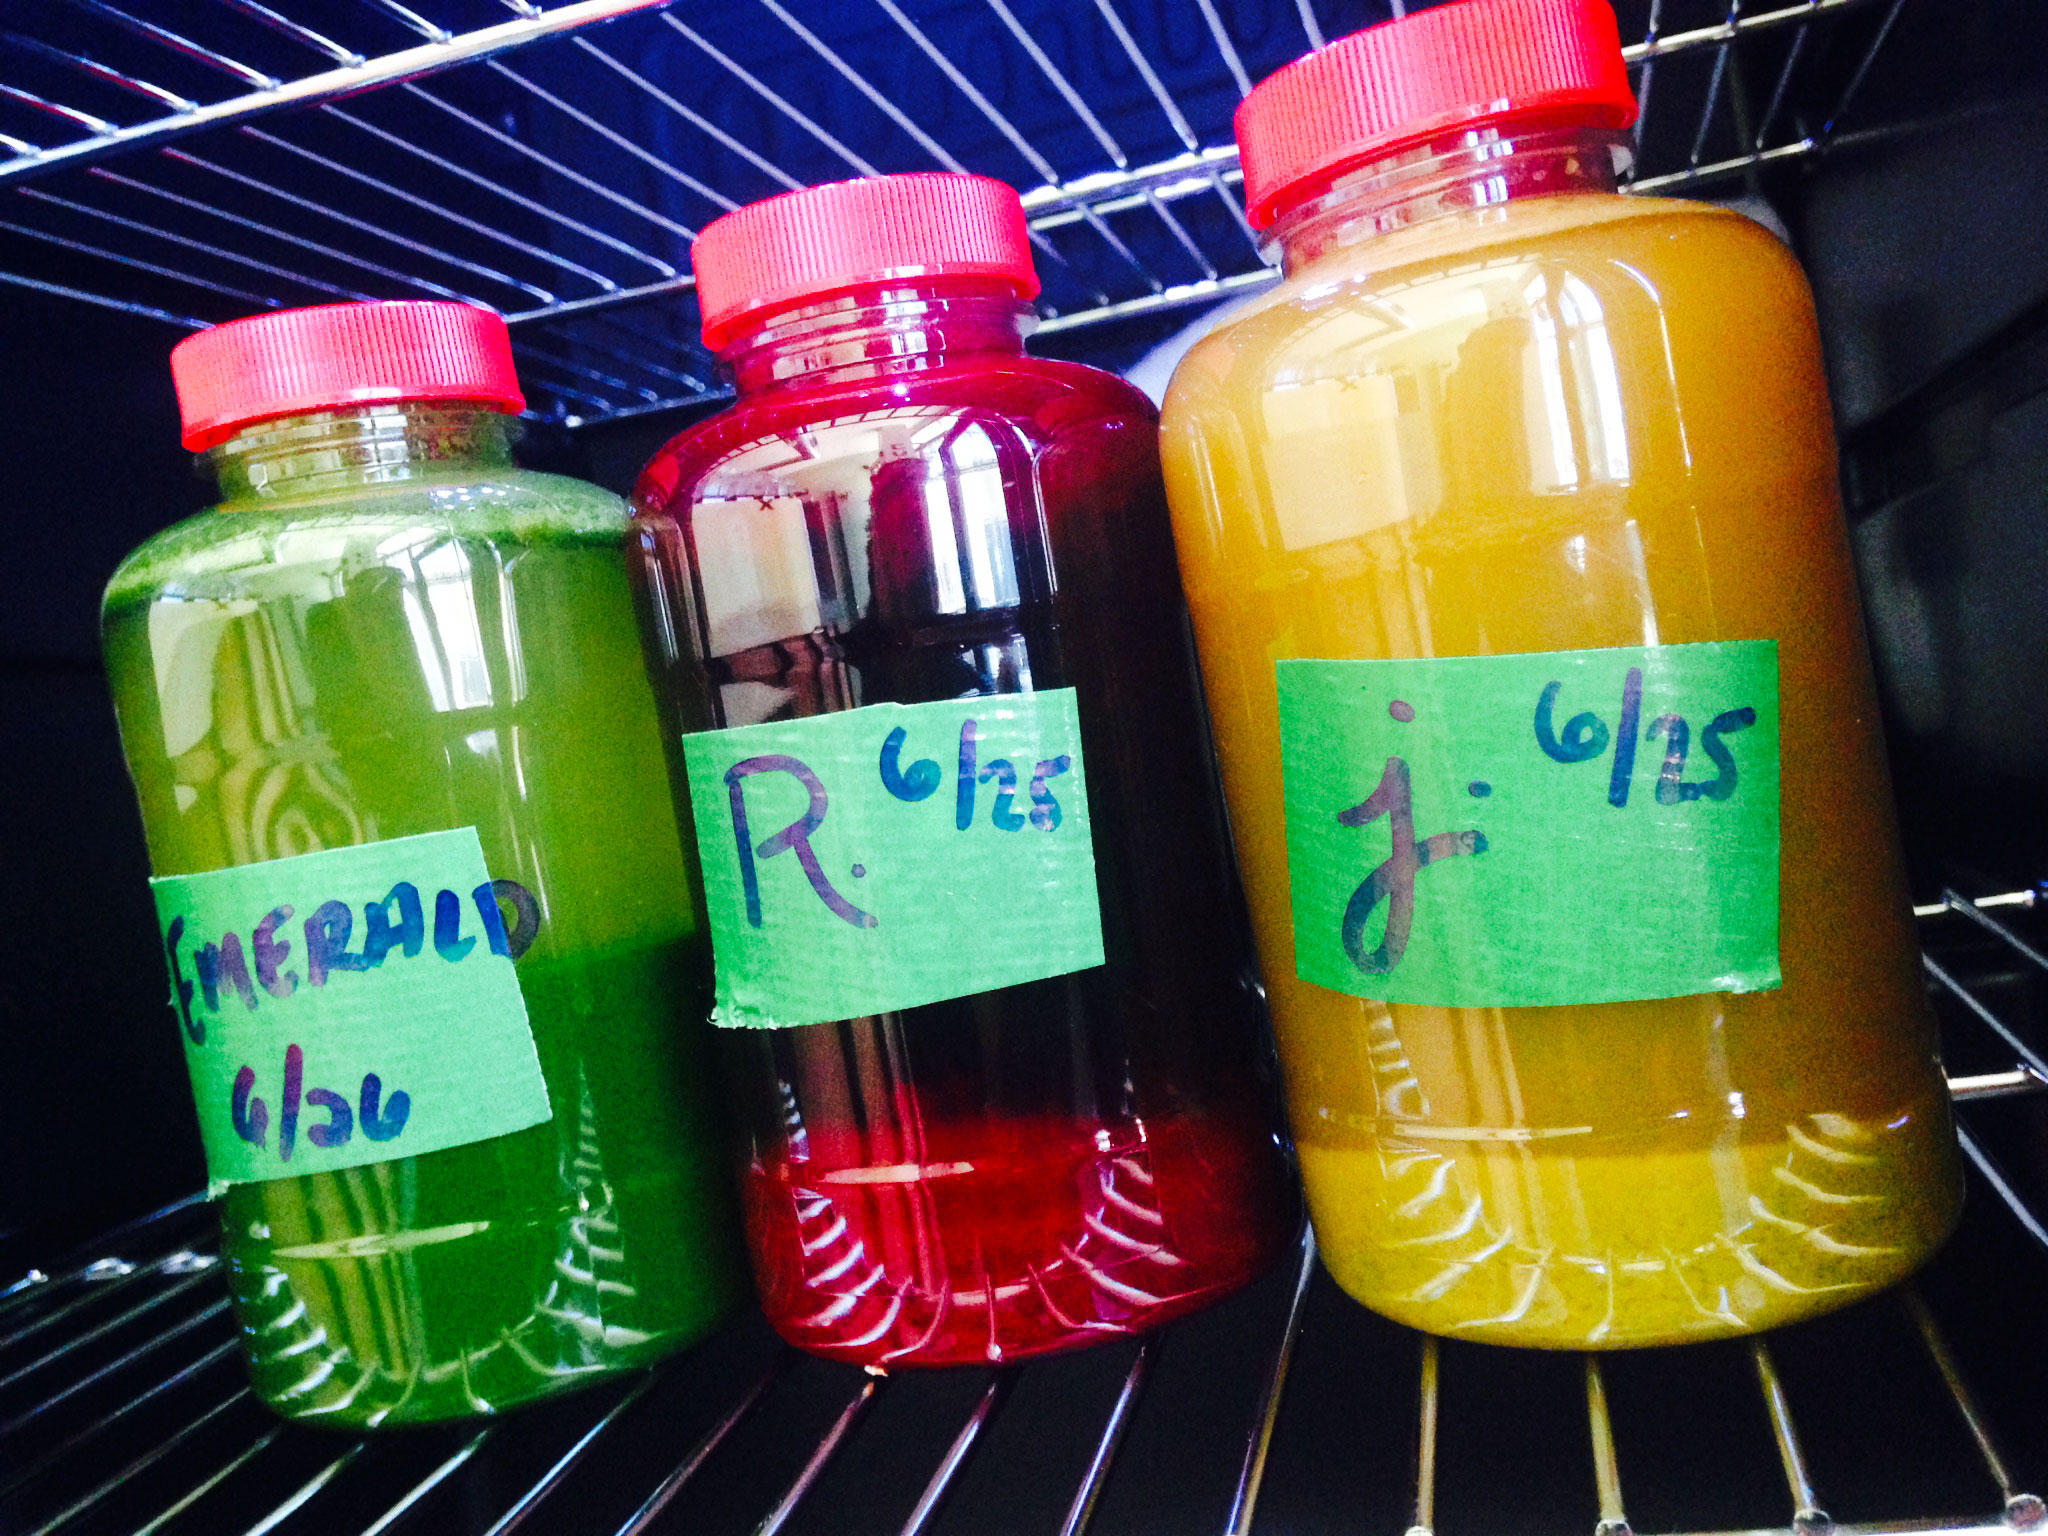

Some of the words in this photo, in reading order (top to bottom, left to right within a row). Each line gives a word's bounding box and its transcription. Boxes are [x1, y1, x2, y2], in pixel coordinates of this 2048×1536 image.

[880, 719, 1071, 832] 6/25
[1534, 667, 1756, 808] 6/25
[168, 879, 541, 1046] EMERALD
[232, 1044, 411, 1162] 6/26
